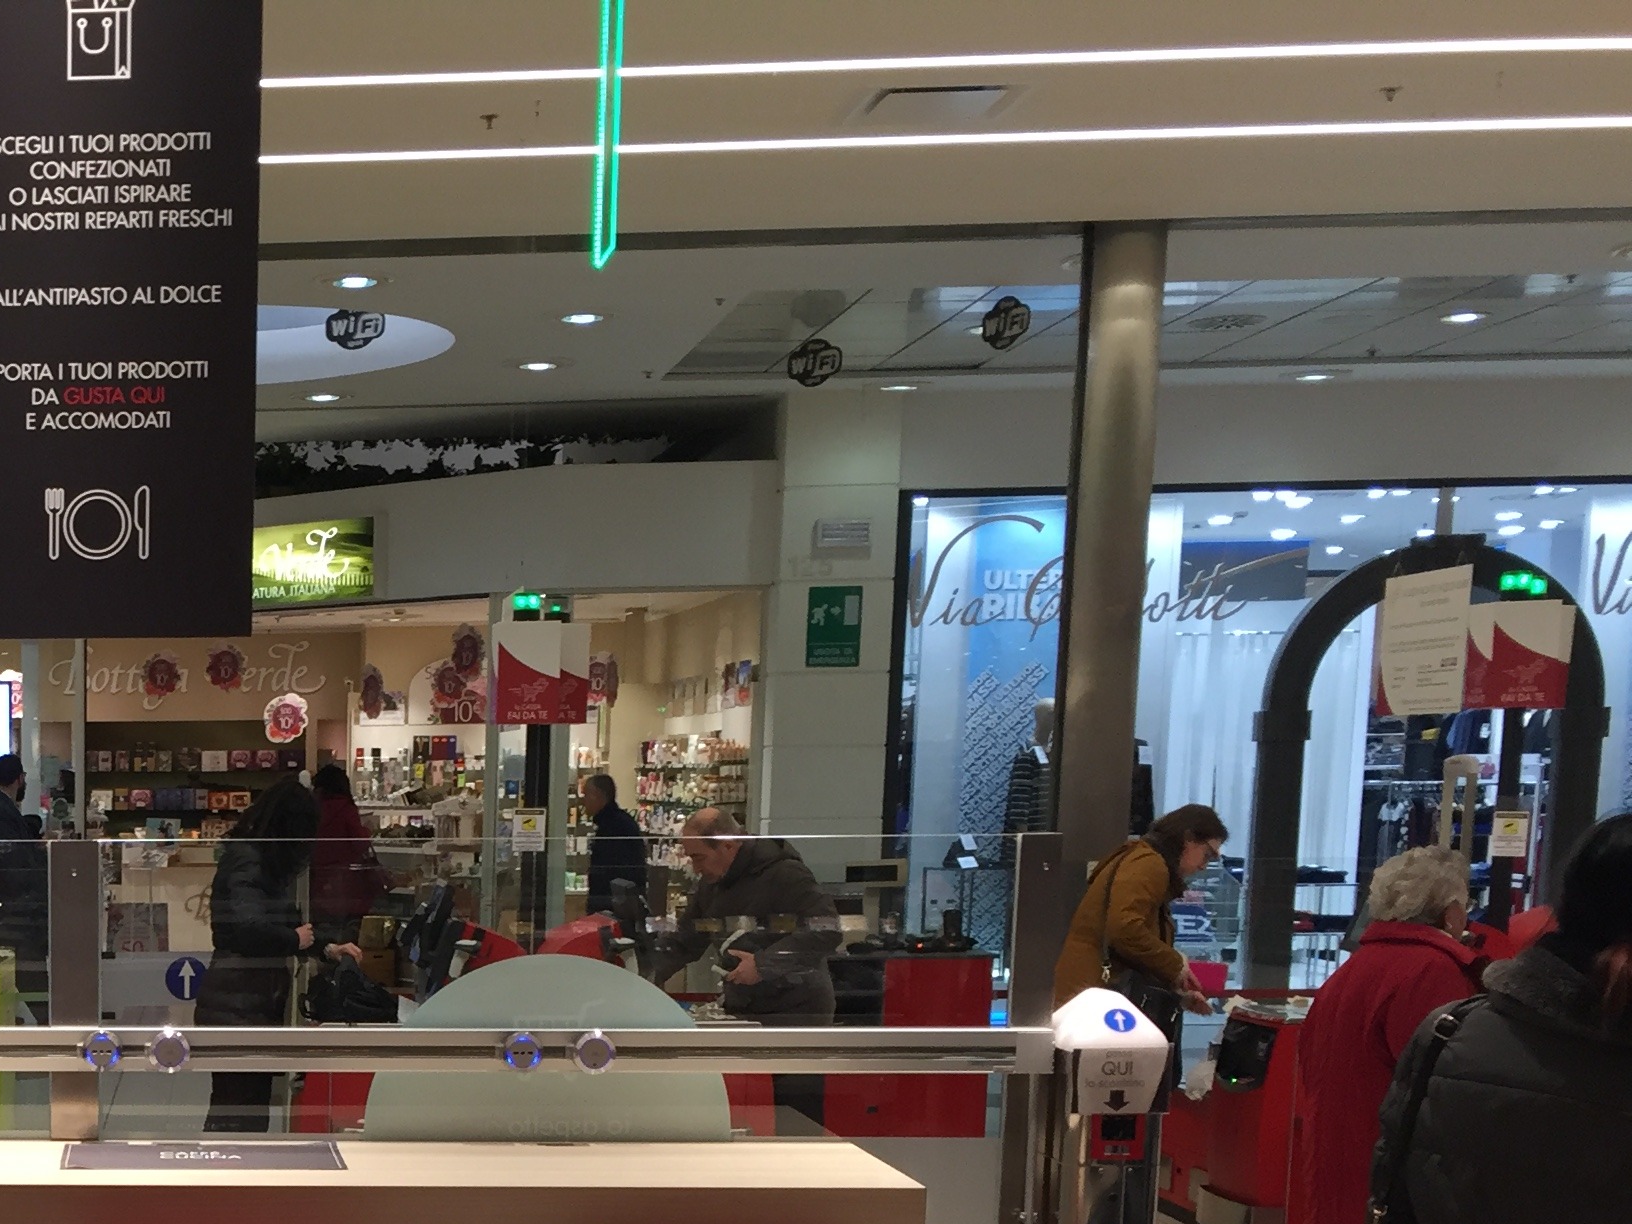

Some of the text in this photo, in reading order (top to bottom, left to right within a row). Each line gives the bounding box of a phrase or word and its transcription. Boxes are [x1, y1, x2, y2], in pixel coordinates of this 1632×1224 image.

[59, 136, 64, 153] I
[69, 134, 113, 153] TUOI
[120, 132, 210, 151] PRODOTTI
[30, 159, 170, 180] CONFEZIONATI
[9, 184, 191, 206] O LASCIATI ISPIRARE
[12, 212, 79, 231] NOSTRI
[85, 211, 153, 229] REPARTI
[159, 209, 232, 227] FRESCHI
[132, 287, 155, 304] AL
[160, 285, 221, 303] DOLCE
[59, 363, 63, 380] I
[68, 362, 112, 380] TUOI
[118, 361, 208, 379] PRODOTTI
[32, 385, 165, 405] DA GUSTA QUI
[26, 411, 170, 430] E ACCOMODATI
[252, 583, 336, 599] ATURA ITALIANA
[204, 641, 326, 694] erde
[522, 711, 537, 720] DA
[538, 710, 548, 719] TE
[1101, 1061, 1133, 1076] QUI
